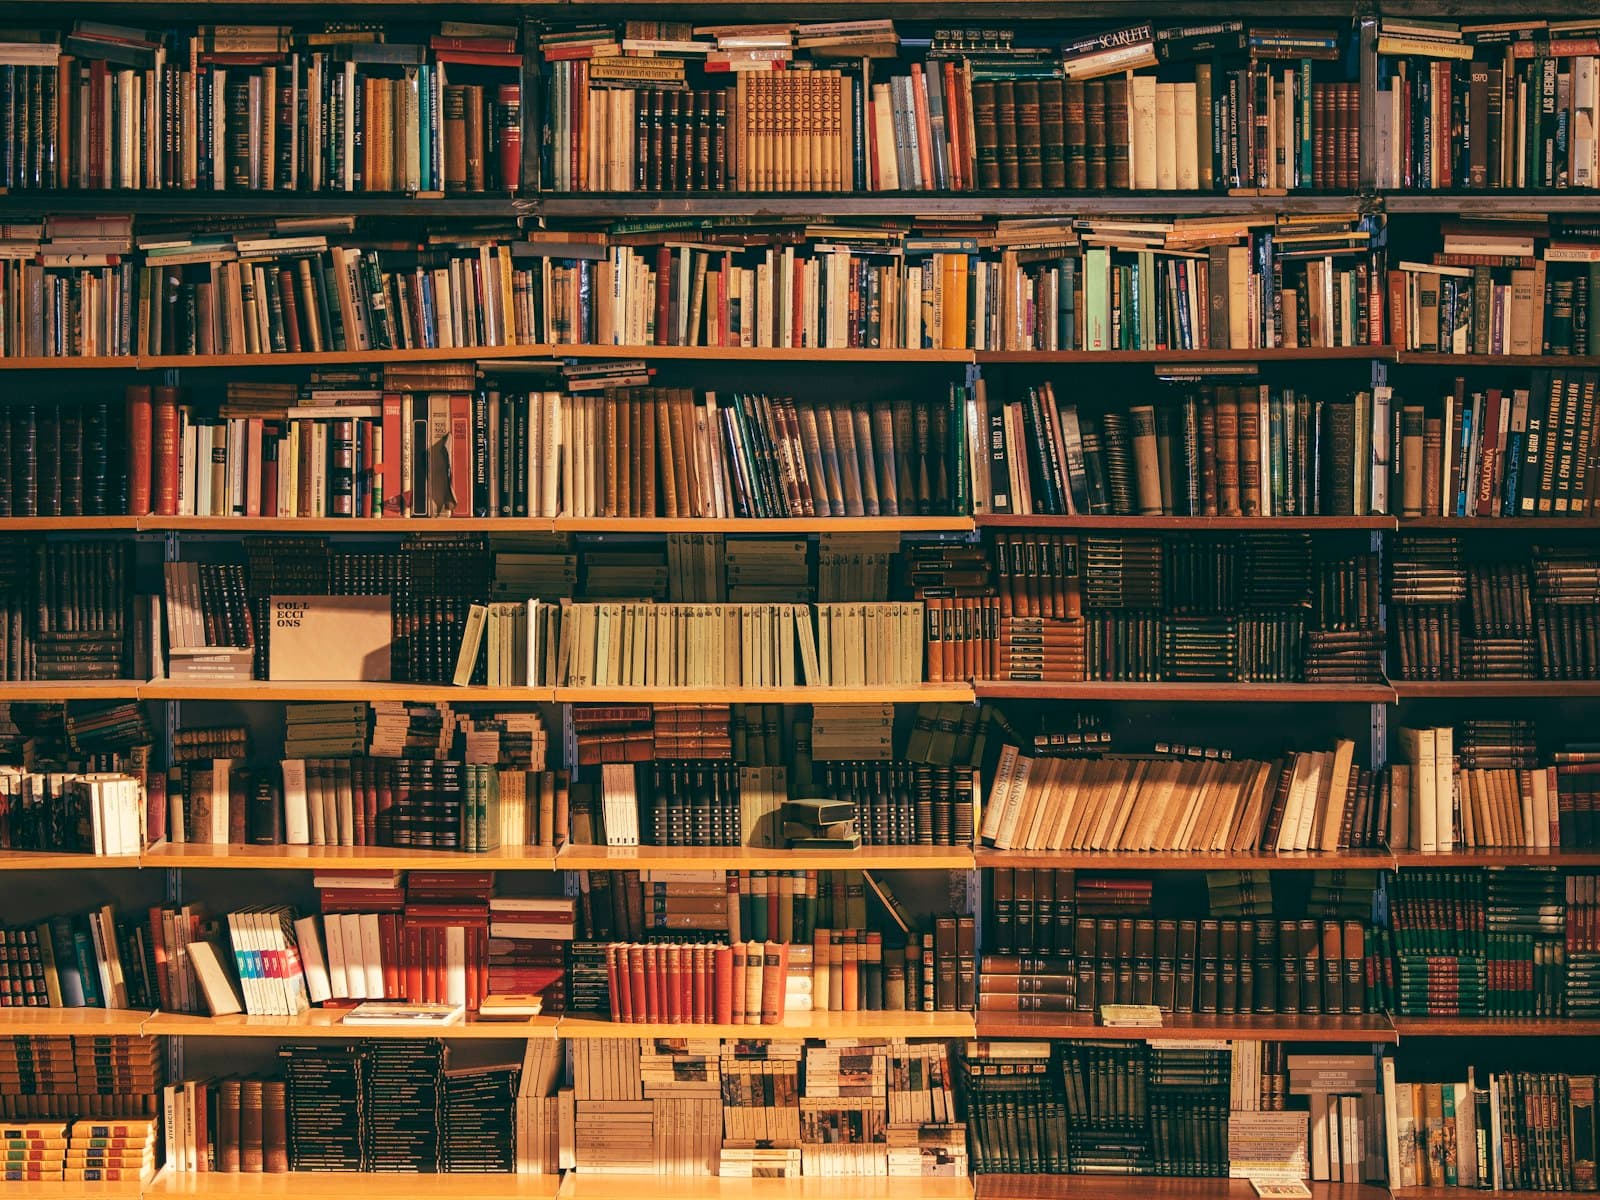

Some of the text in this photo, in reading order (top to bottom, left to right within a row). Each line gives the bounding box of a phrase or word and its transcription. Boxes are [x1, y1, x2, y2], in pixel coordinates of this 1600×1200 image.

[1098, 25, 1150, 48] SCARLETT
[1472, 73, 1487, 82] 1970
[1544, 60, 1555, 113] LAS CIENCIAS
[746, 76, 756, 136] BRICOLAJE
[822, 76, 831, 136] BRICOLAJE
[992, 416, 1002, 426] XX
[1564, 383, 1579, 425] EXPANSIÓN
[1580, 383, 1594, 427] OCCIDENTAL
[993, 431, 1003, 449] SIGLO
[1509, 434, 1520, 472] LATINA
[1527, 420, 1540, 463] EL SIGLO XX
[1542, 380, 1562, 490] CIVILIZACIONES EXTINGUIDAS
[1562, 441, 1572, 451] DE
[1574, 431, 1589, 478] CIVILIZACIÓN
[1040, 452, 1050, 480] ANIMALI
[1480, 448, 1494, 501] CATALONIA
[1558, 455, 1571, 478] ÉPOCA
[277, 611, 304, 619] ECCI
[998, 752, 1014, 796] PARNASO
[1010, 764, 1026, 806] PARNASO
